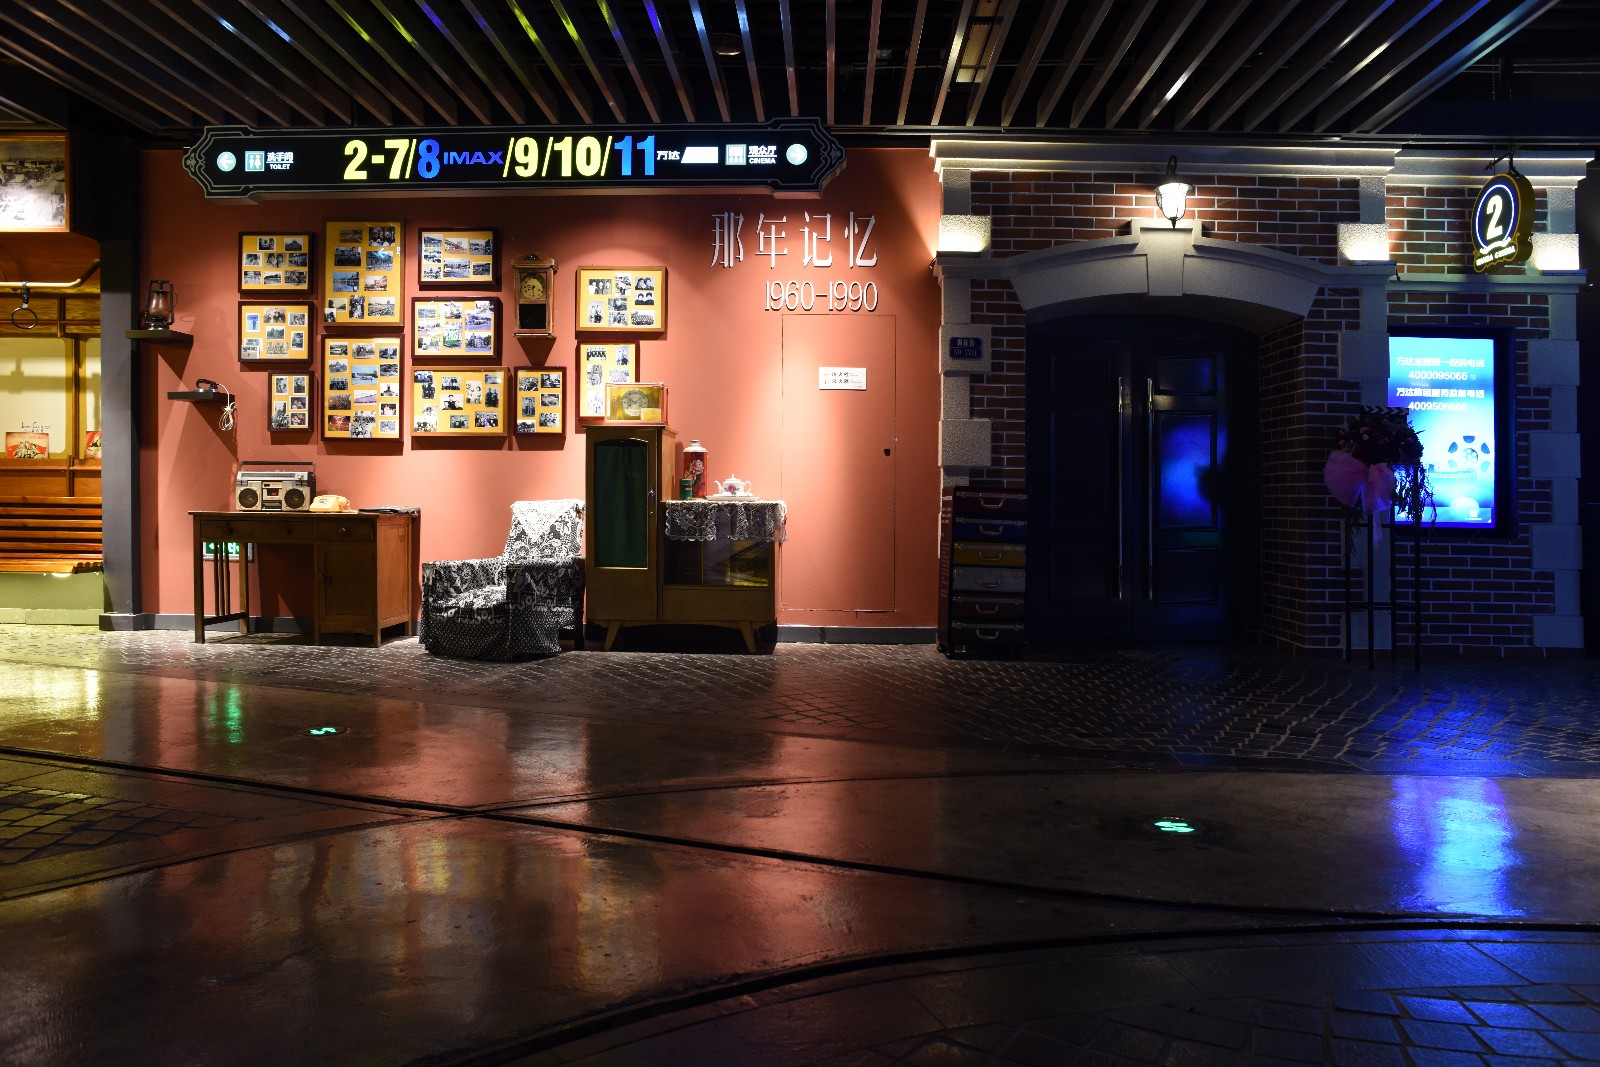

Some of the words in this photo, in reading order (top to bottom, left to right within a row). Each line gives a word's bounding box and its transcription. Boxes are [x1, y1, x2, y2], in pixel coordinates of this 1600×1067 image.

[656, 150, 681, 160] 万达
[748, 145, 777, 155] 观众厅
[1486, 195, 1503, 240] 2
[711, 211, 878, 269] 那年记忆
[765, 281, 878, 311] 1960-1990
[1408, 370, 1468, 380] 4000095066
